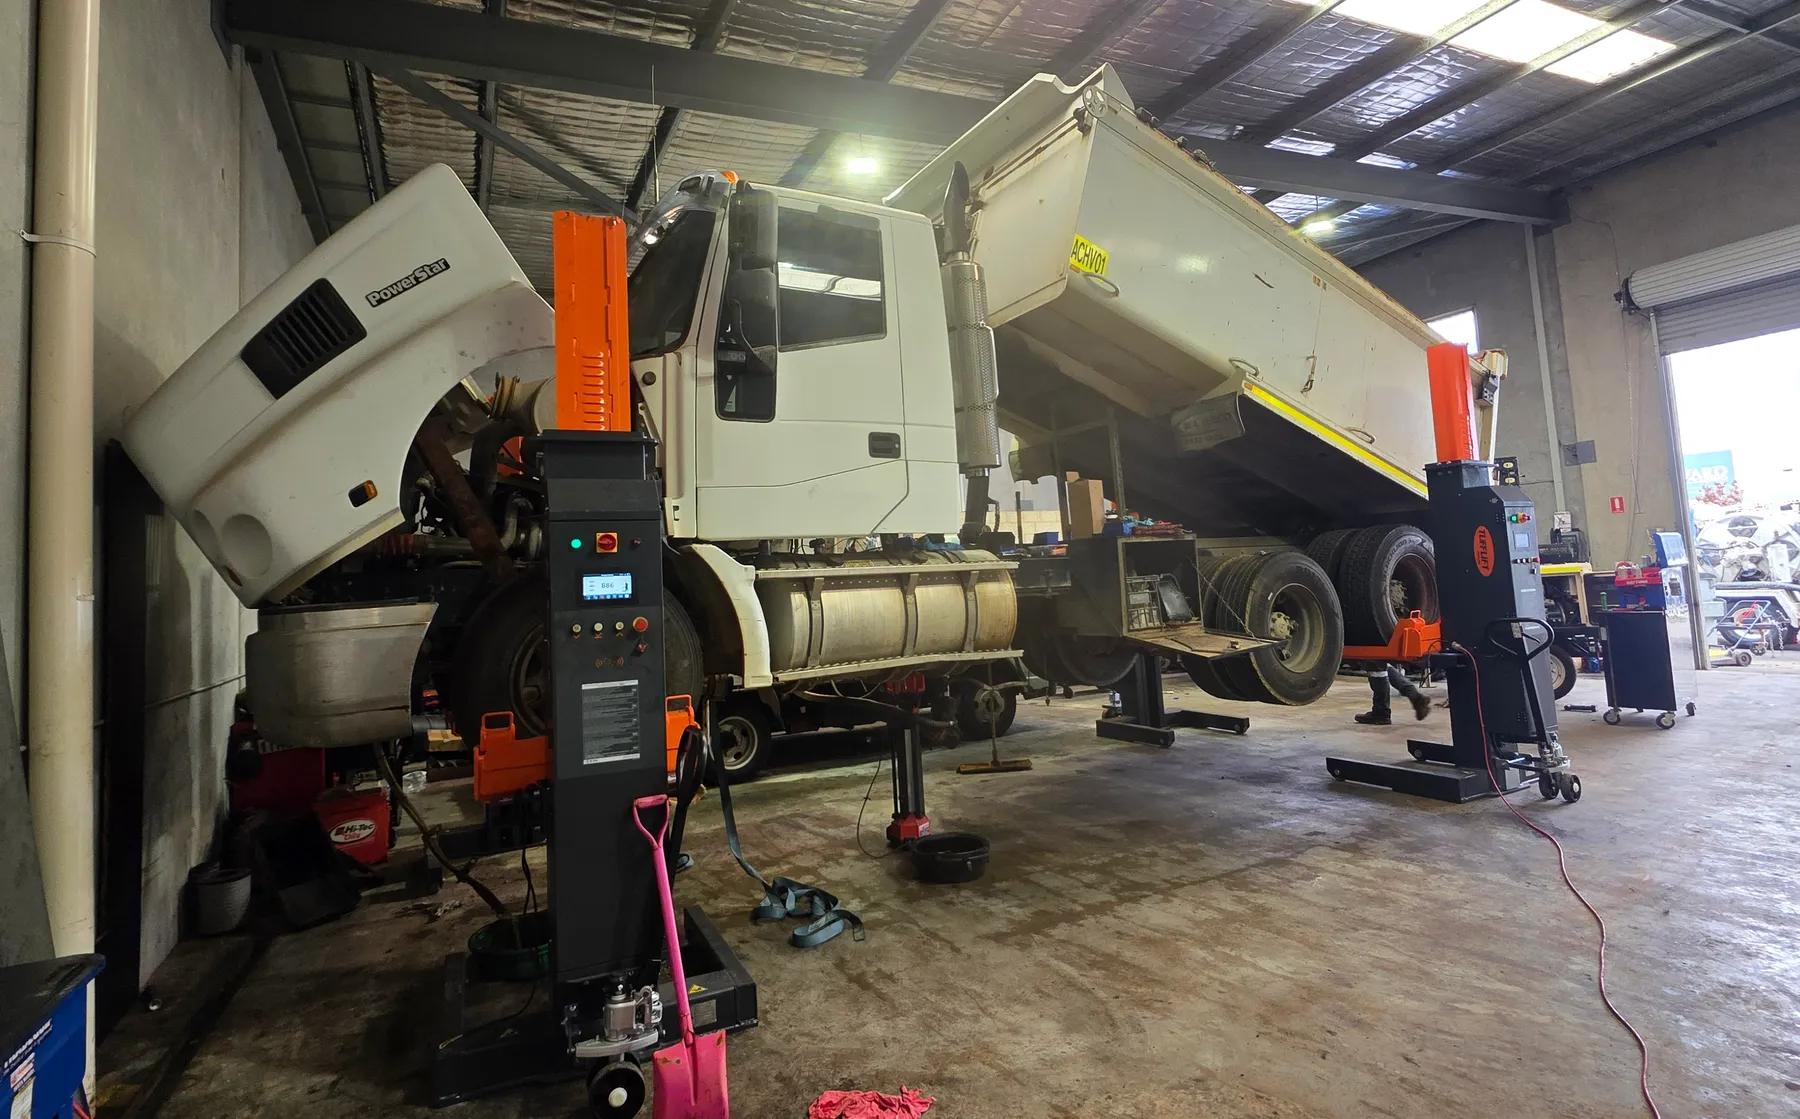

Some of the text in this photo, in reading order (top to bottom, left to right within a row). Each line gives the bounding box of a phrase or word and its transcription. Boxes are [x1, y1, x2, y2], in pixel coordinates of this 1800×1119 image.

[1071, 238, 1107, 275] ACHV01
[366, 259, 447, 306] PowerStar
[1479, 528, 1490, 572] TUFFLIFT
[344, 823, 375, 834] Hi-Tec
